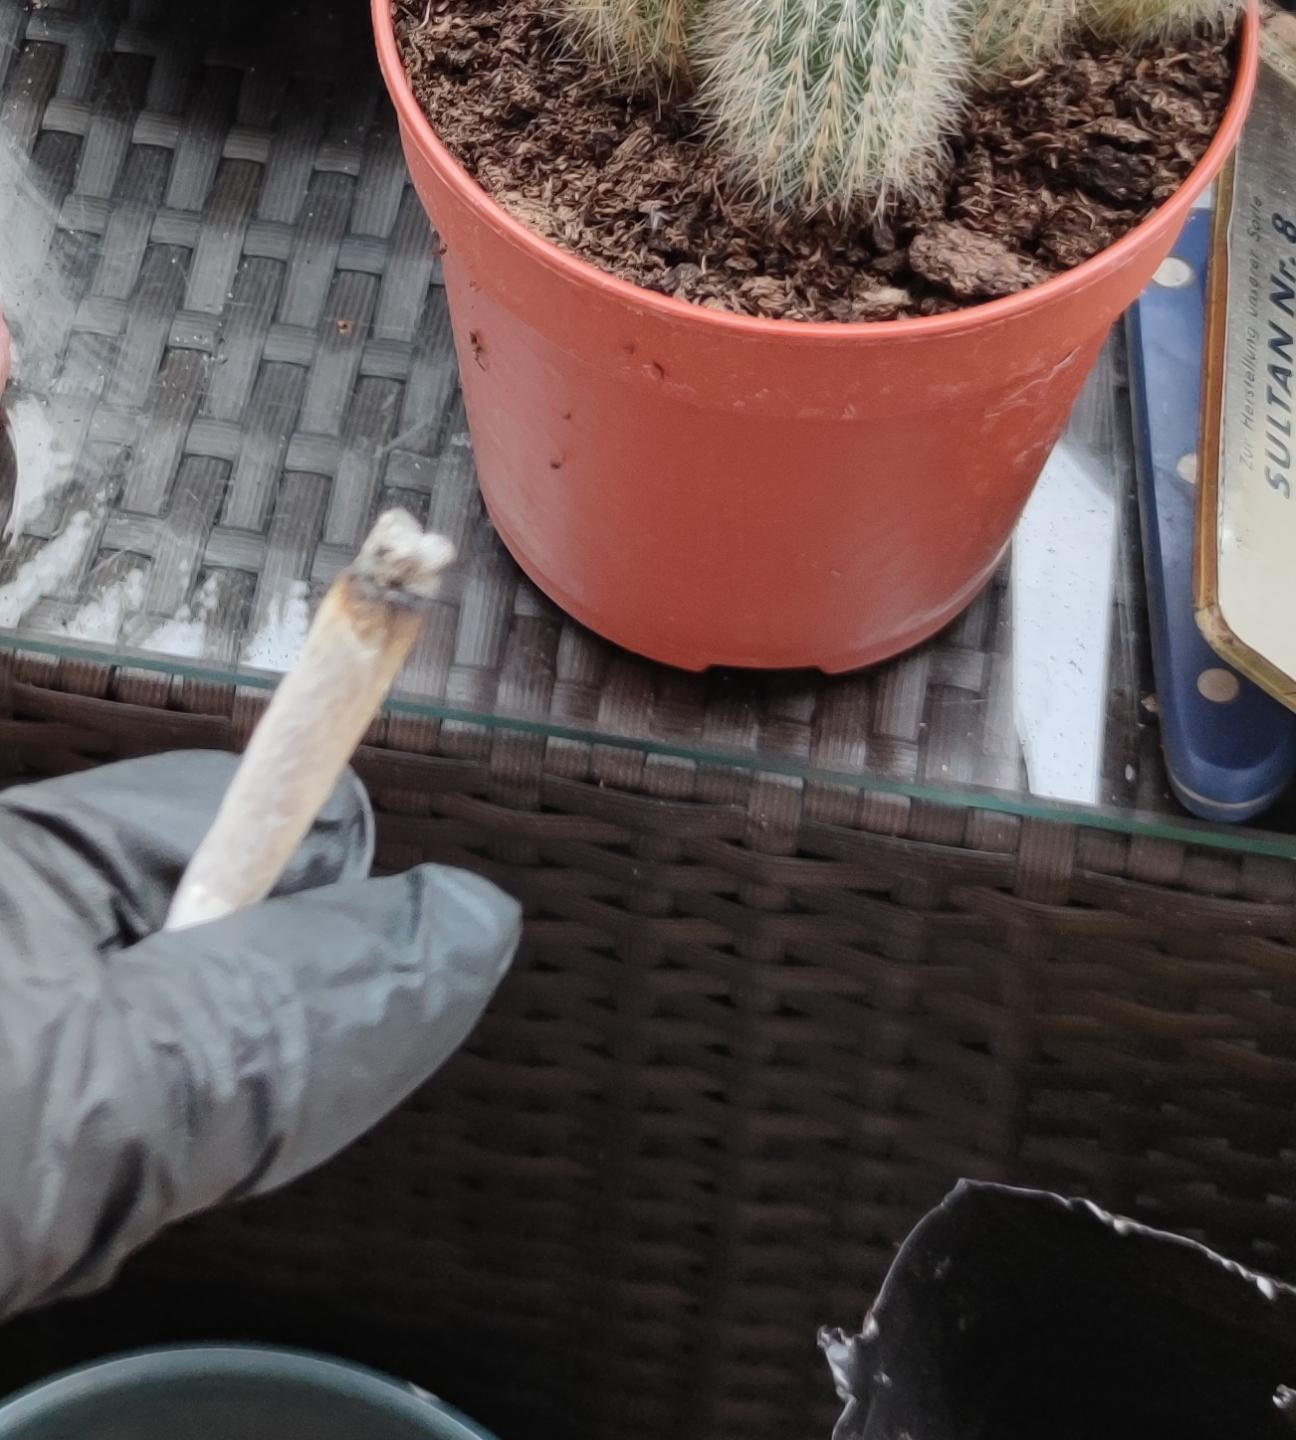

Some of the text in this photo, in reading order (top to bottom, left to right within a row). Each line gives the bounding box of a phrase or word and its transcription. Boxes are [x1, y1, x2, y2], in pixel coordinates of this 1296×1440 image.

[1265, 212, 1296, 501] SULTAN Nr. 8
